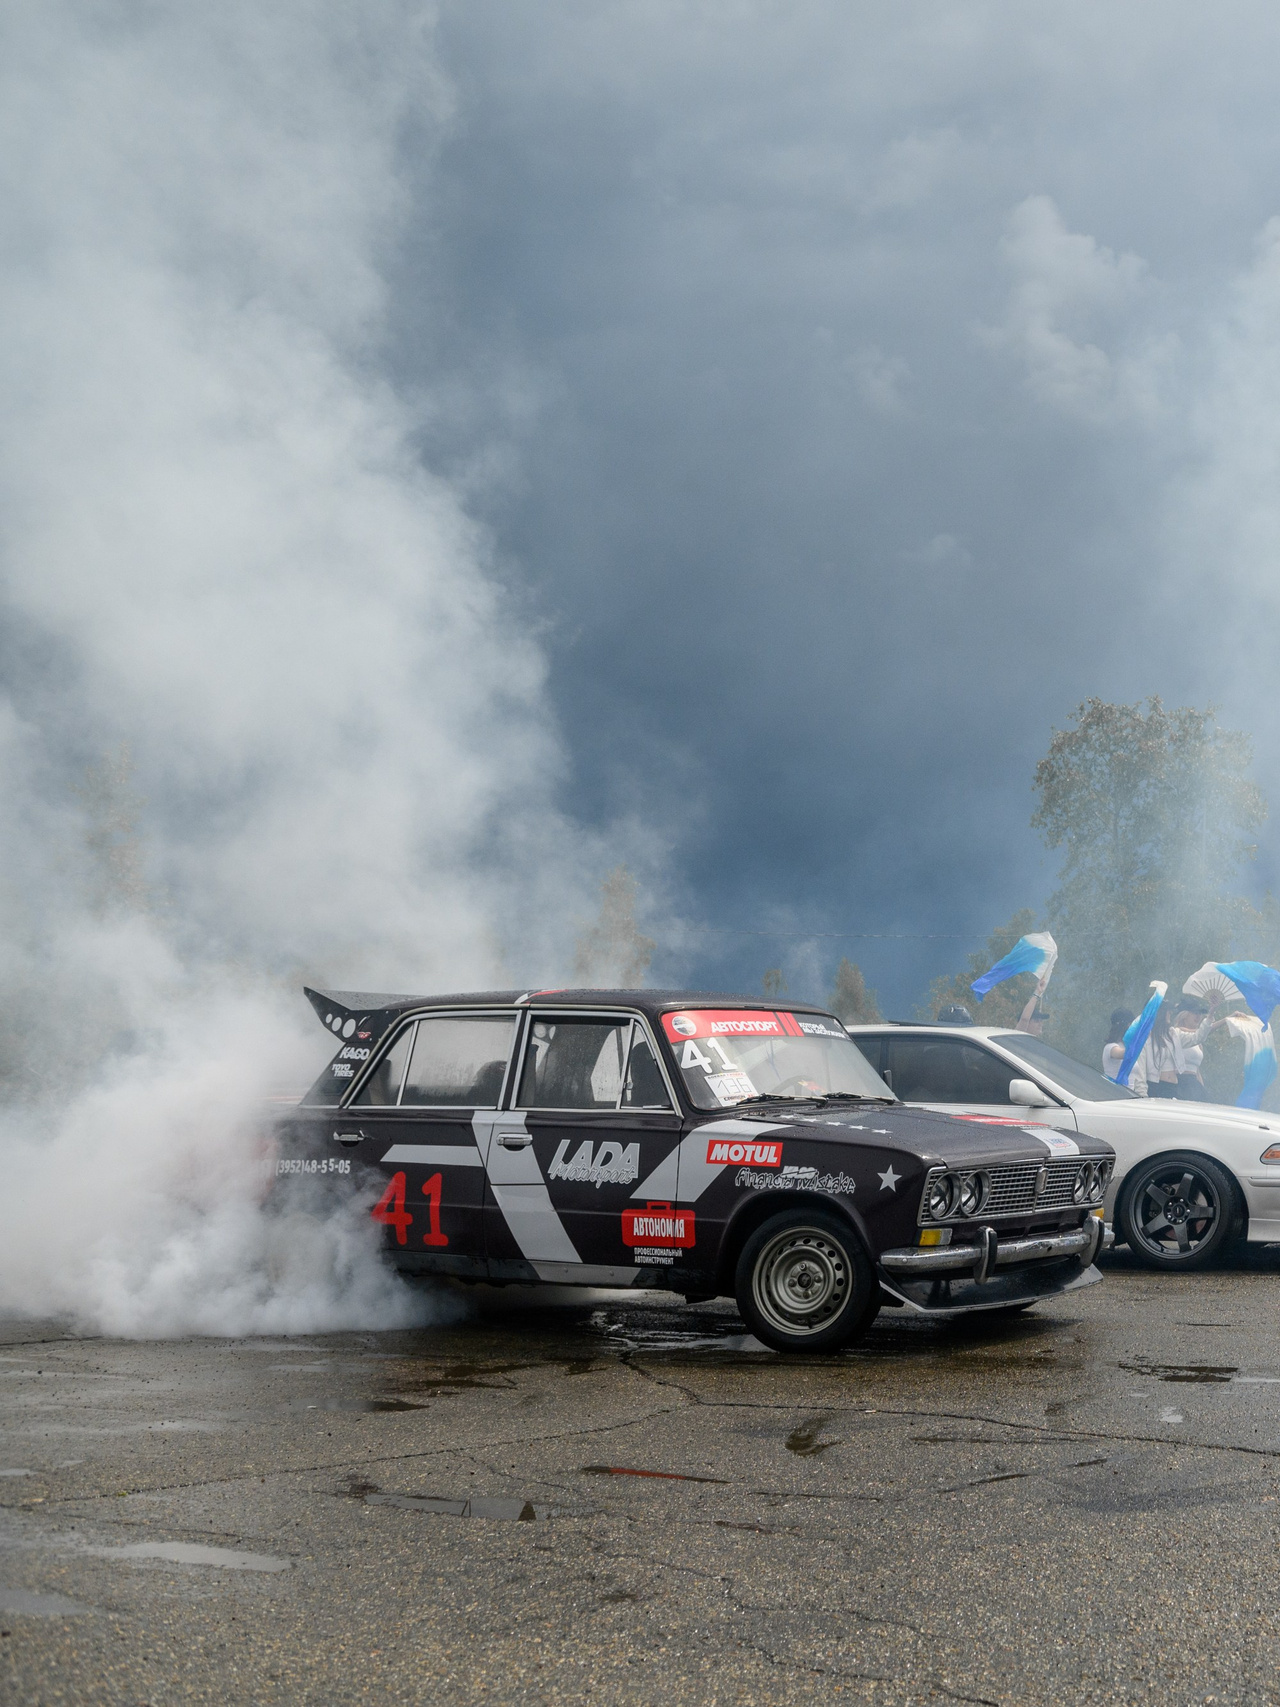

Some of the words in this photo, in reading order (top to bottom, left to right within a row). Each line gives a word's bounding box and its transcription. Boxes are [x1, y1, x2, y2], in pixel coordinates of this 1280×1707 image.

[711, 1021, 778, 1033] АВТОСПОРТ
[680, 1037, 738, 1073] 41
[547, 1139, 640, 1179] LADA
[710, 1143, 778, 1163] MOTUL
[371, 1171, 448, 1246] 41
[633, 1217, 685, 1238] АВТОНОМИЯ
